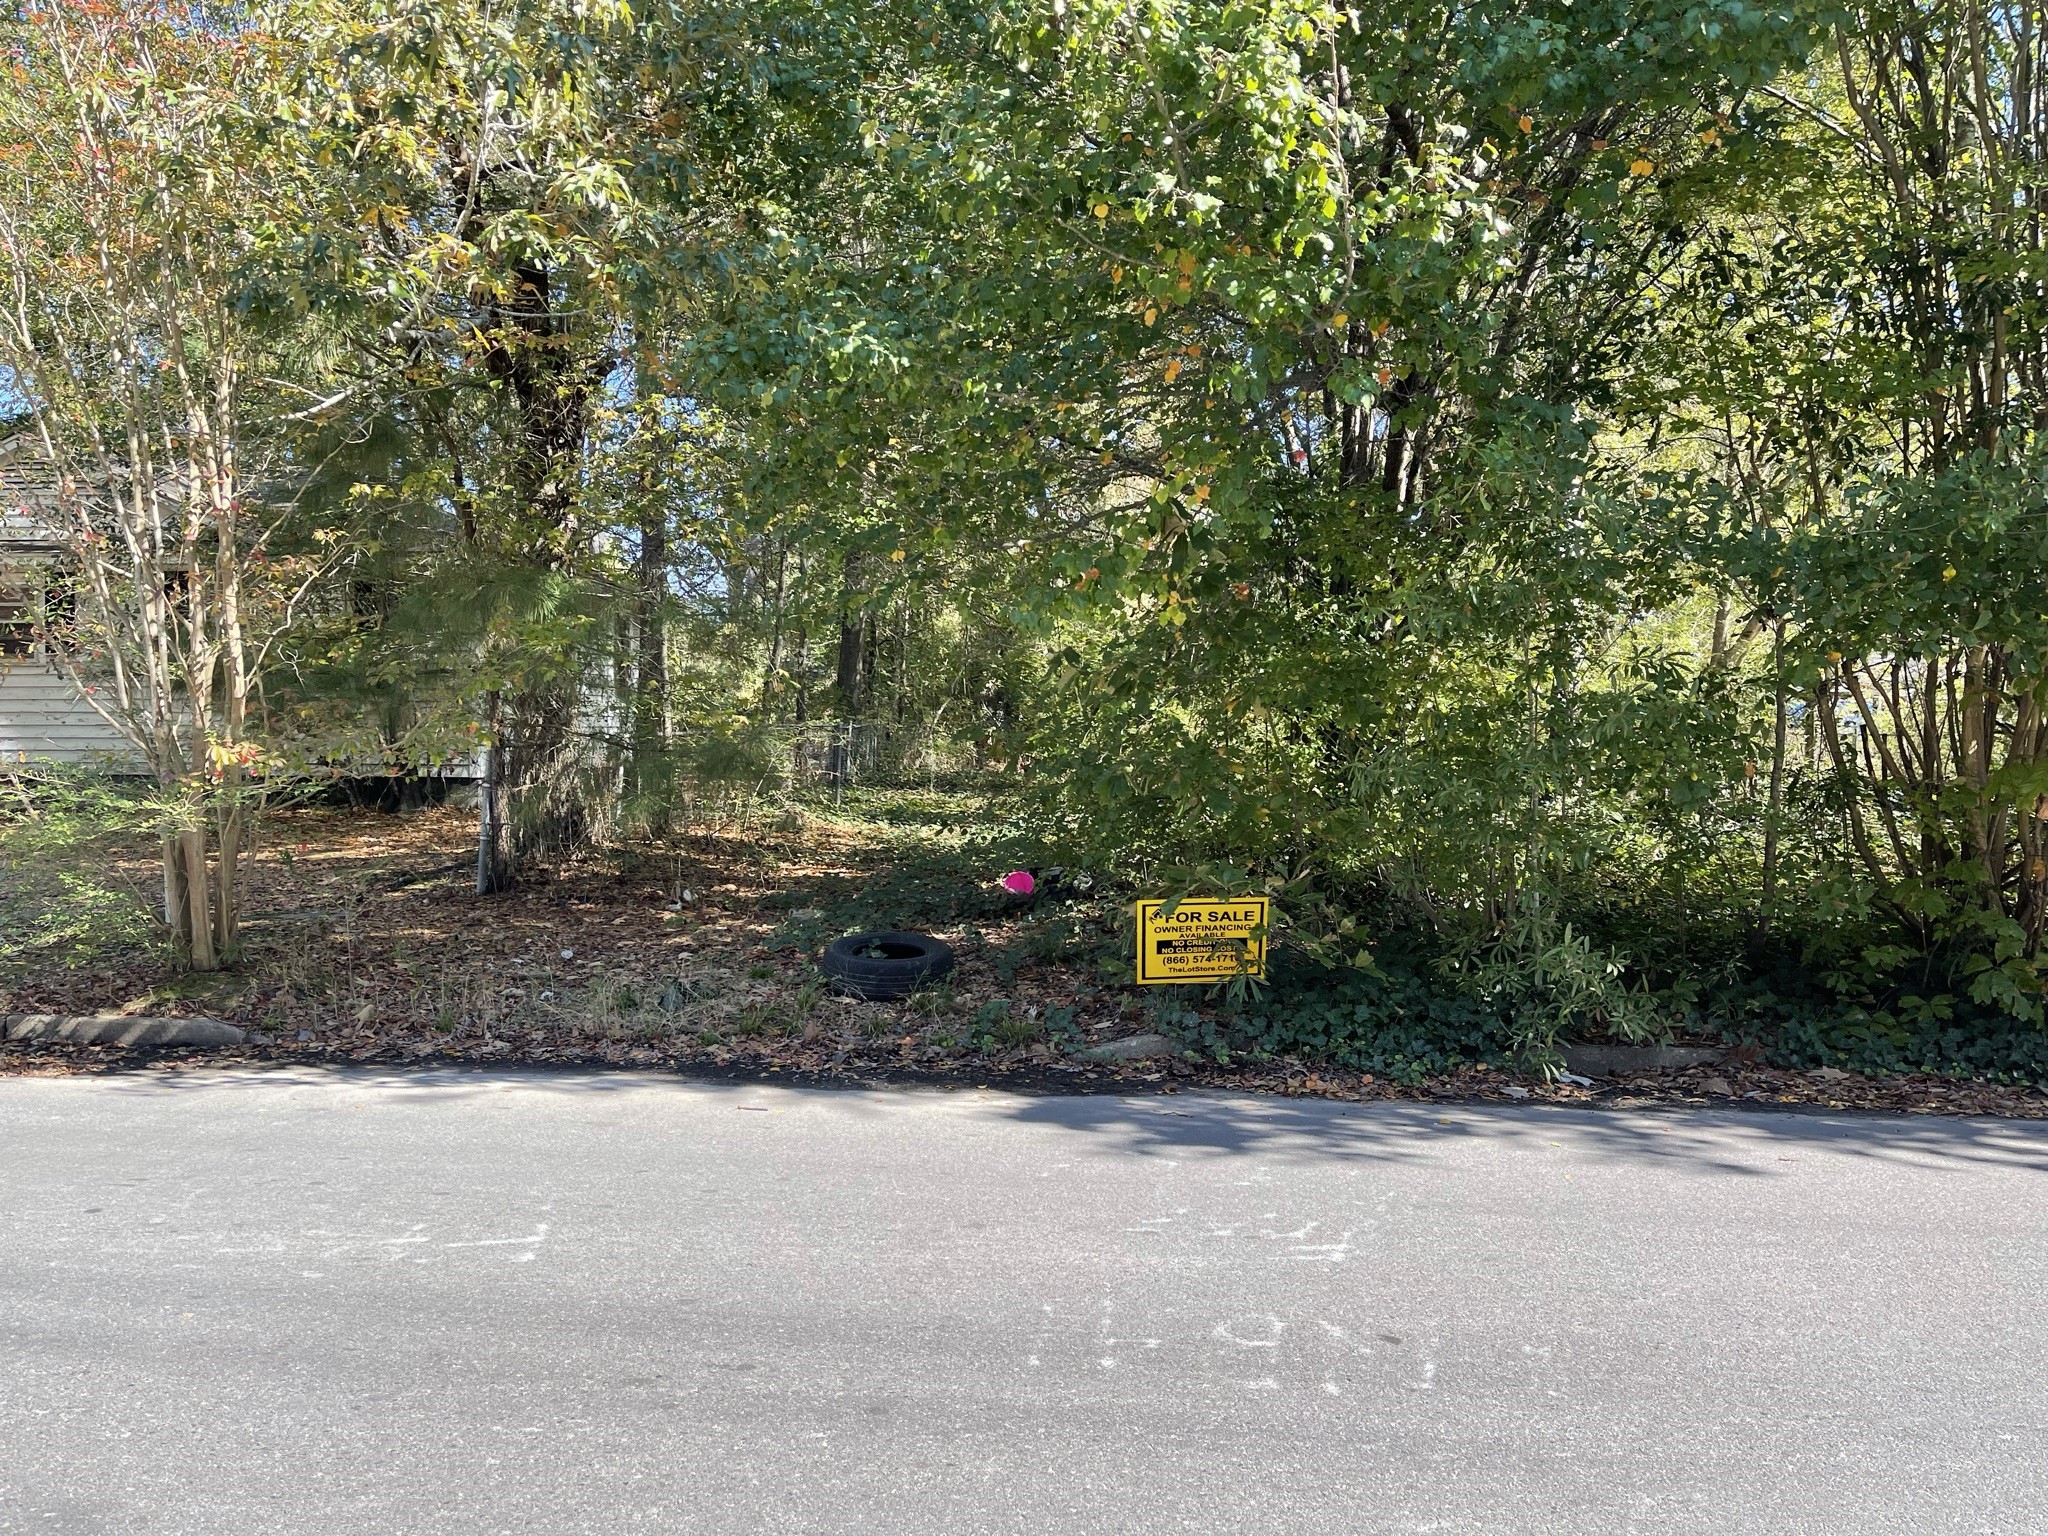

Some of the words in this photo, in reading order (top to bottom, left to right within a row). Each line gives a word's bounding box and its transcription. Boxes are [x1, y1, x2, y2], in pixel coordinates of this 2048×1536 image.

[1165, 912, 1202, 924] FOR
[1208, 910, 1255, 922] SALE
[1154, 925, 1193, 934] OWNER
[1196, 924, 1252, 932] FINANCING
[1162, 956, 1189, 966] (866)
[1194, 954, 1240, 964] 574-171
